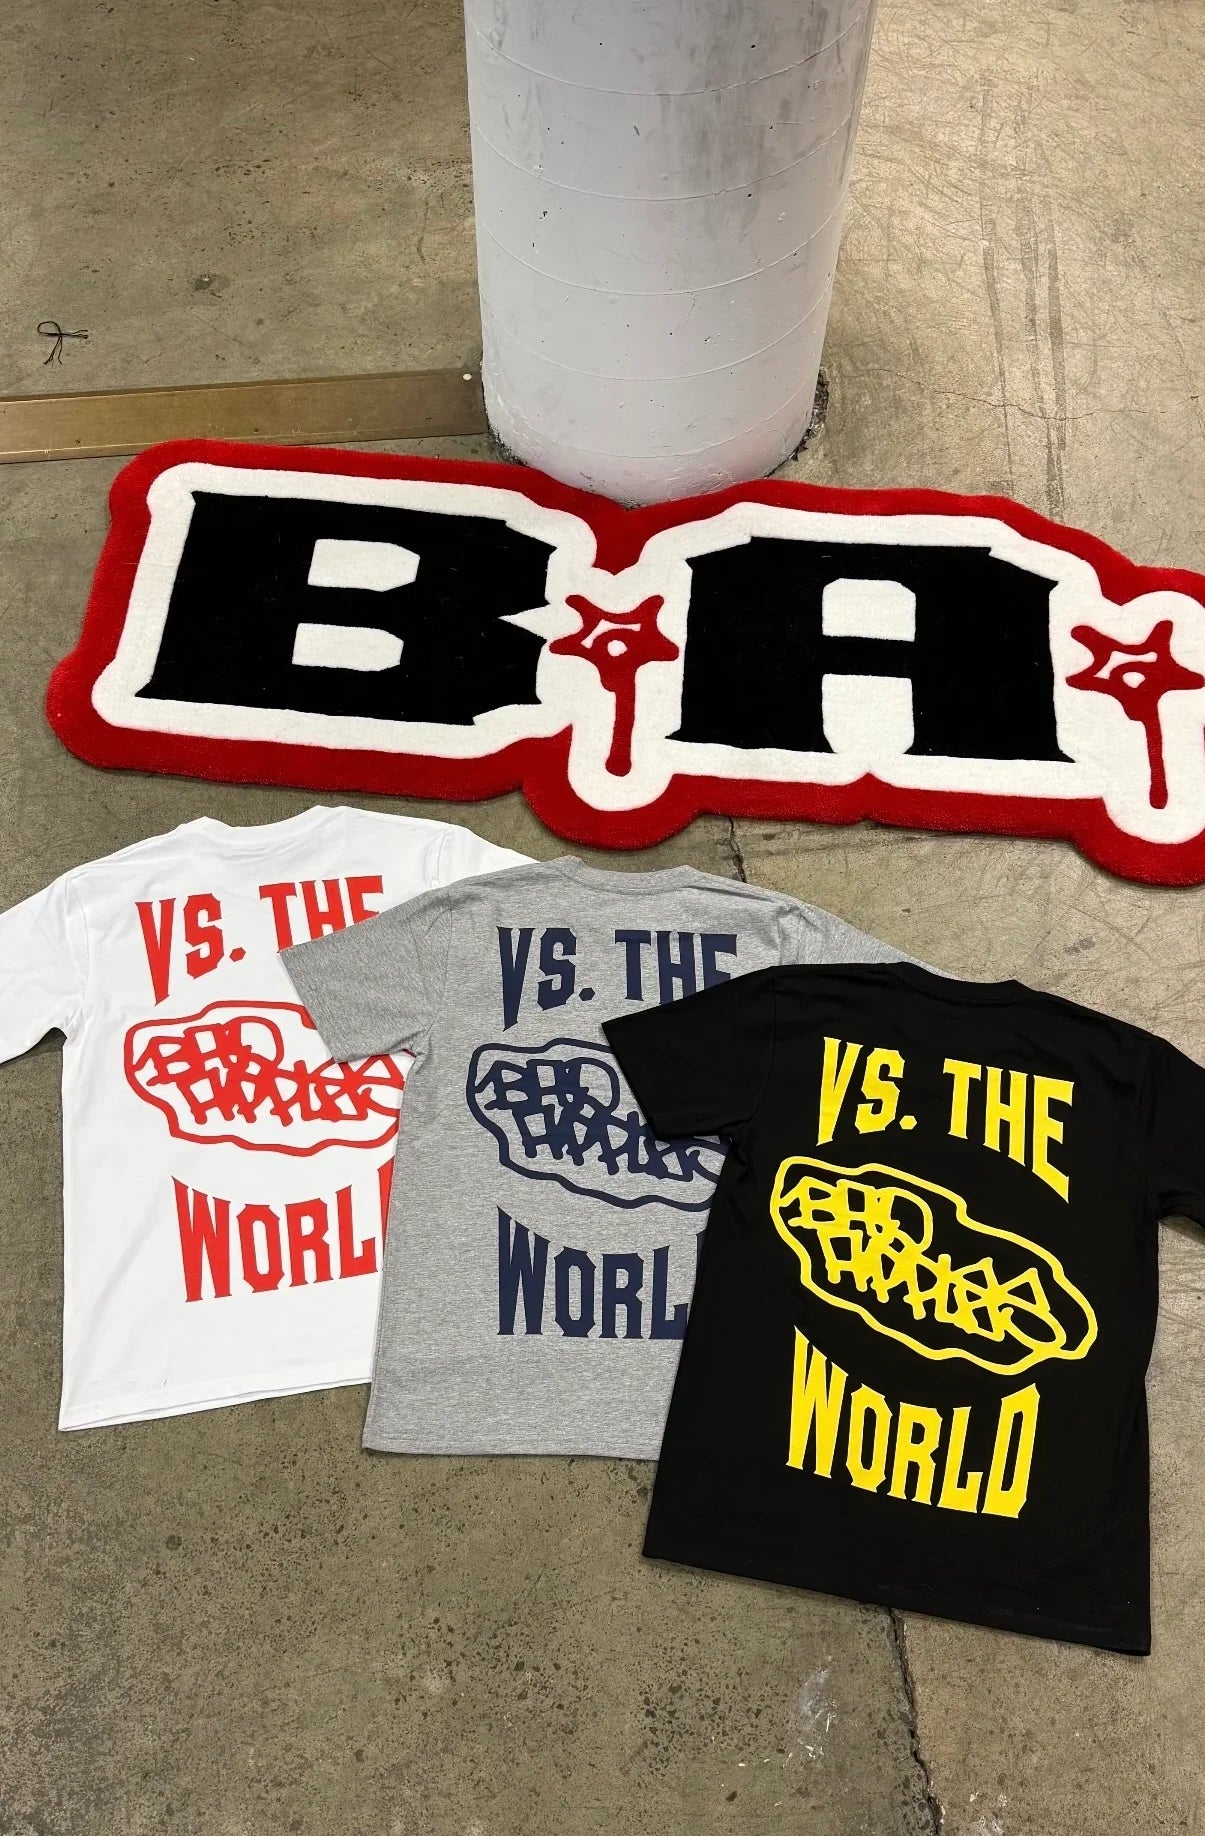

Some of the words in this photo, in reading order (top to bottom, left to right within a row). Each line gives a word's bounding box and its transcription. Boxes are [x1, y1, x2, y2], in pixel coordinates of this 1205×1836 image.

[135, 892, 246, 1006] VS.
[496, 926, 596, 1033] VS.
[614, 929, 738, 1008] THE
[816, 1036, 917, 1146] VS.
[942, 1057, 1075, 1203] THE
[496, 1206, 706, 1340] WORL
[786, 1325, 1041, 1519] WORLD
